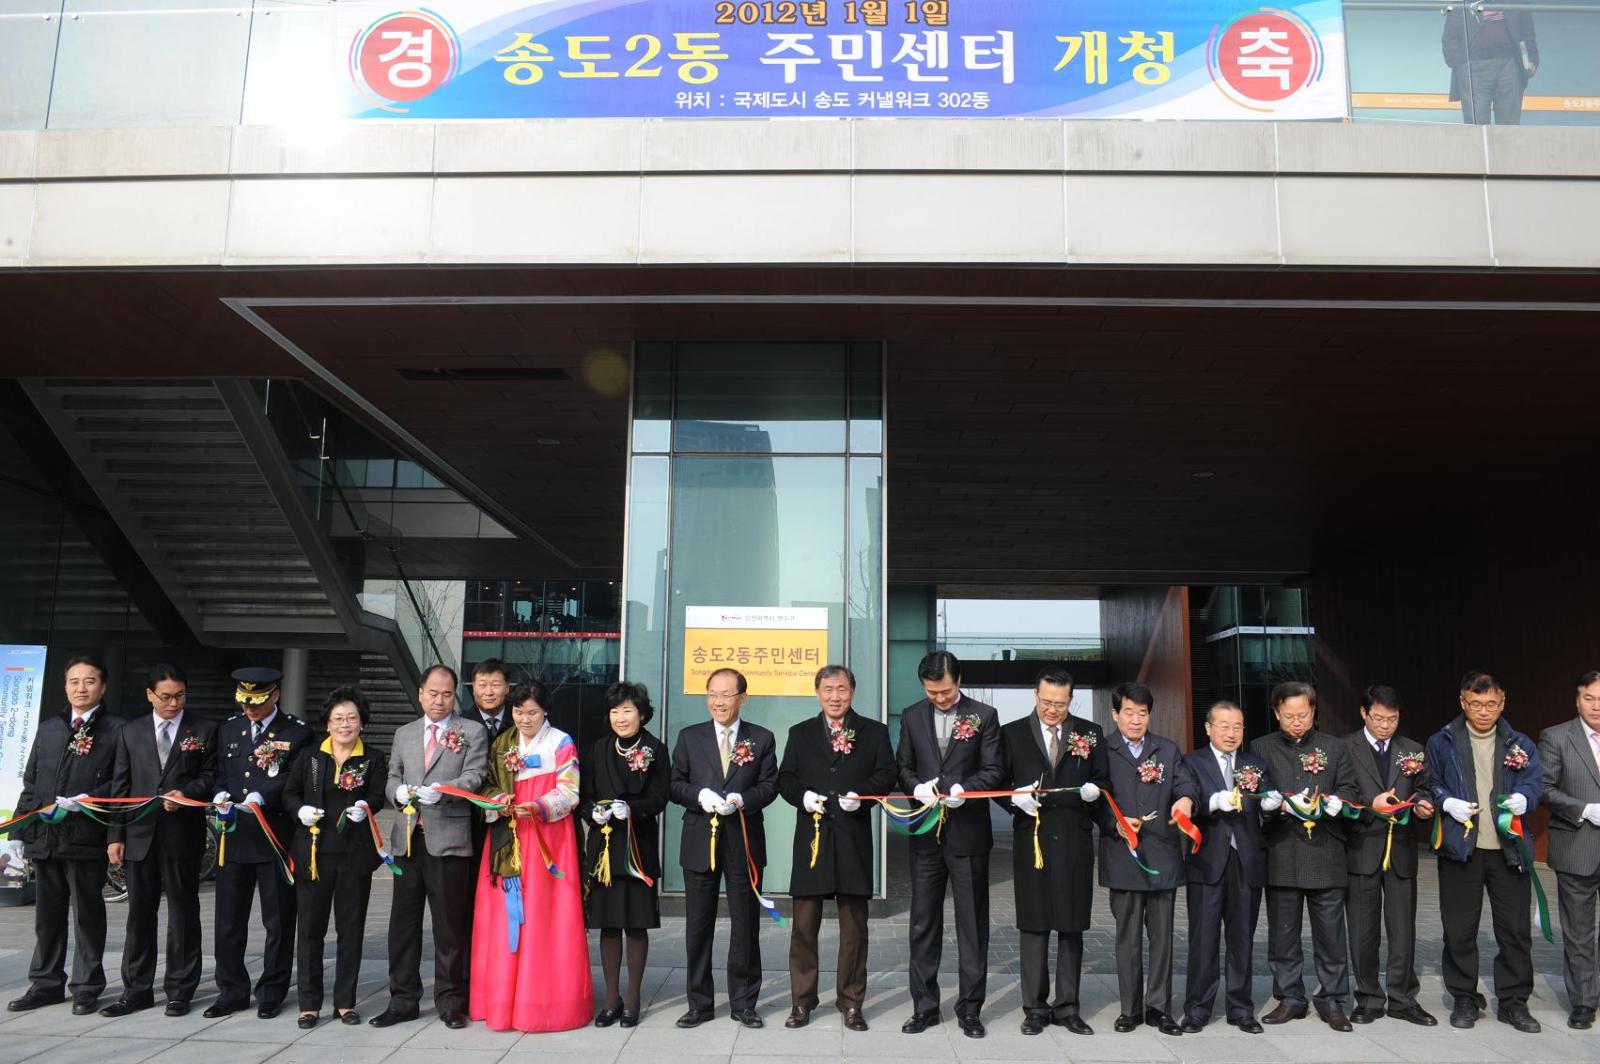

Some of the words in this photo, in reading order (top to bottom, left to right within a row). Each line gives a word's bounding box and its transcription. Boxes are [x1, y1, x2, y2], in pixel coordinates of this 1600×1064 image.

[714, 0, 829, 26] 2012년
[844, 0, 889, 26] 1월
[905, 0, 951, 26] 1일
[378, 28, 433, 88] 경
[494, 31, 729, 86] 송도2동
[759, 29, 1015, 85] 주민센터
[1053, 30, 1175, 86] 개청
[1236, 27, 1293, 91] 축
[674, 91, 711, 110] 위치
[733, 91, 806, 109] 국제도시
[813, 91, 850, 109] 송도
[857, 91, 931, 110] 커낼워크
[938, 91, 991, 109] 302동
[692, 646, 820, 665] 송도2동주민센터
[11, 674, 22, 705] Songdo
[7, 706, 19, 737] 2-dong
